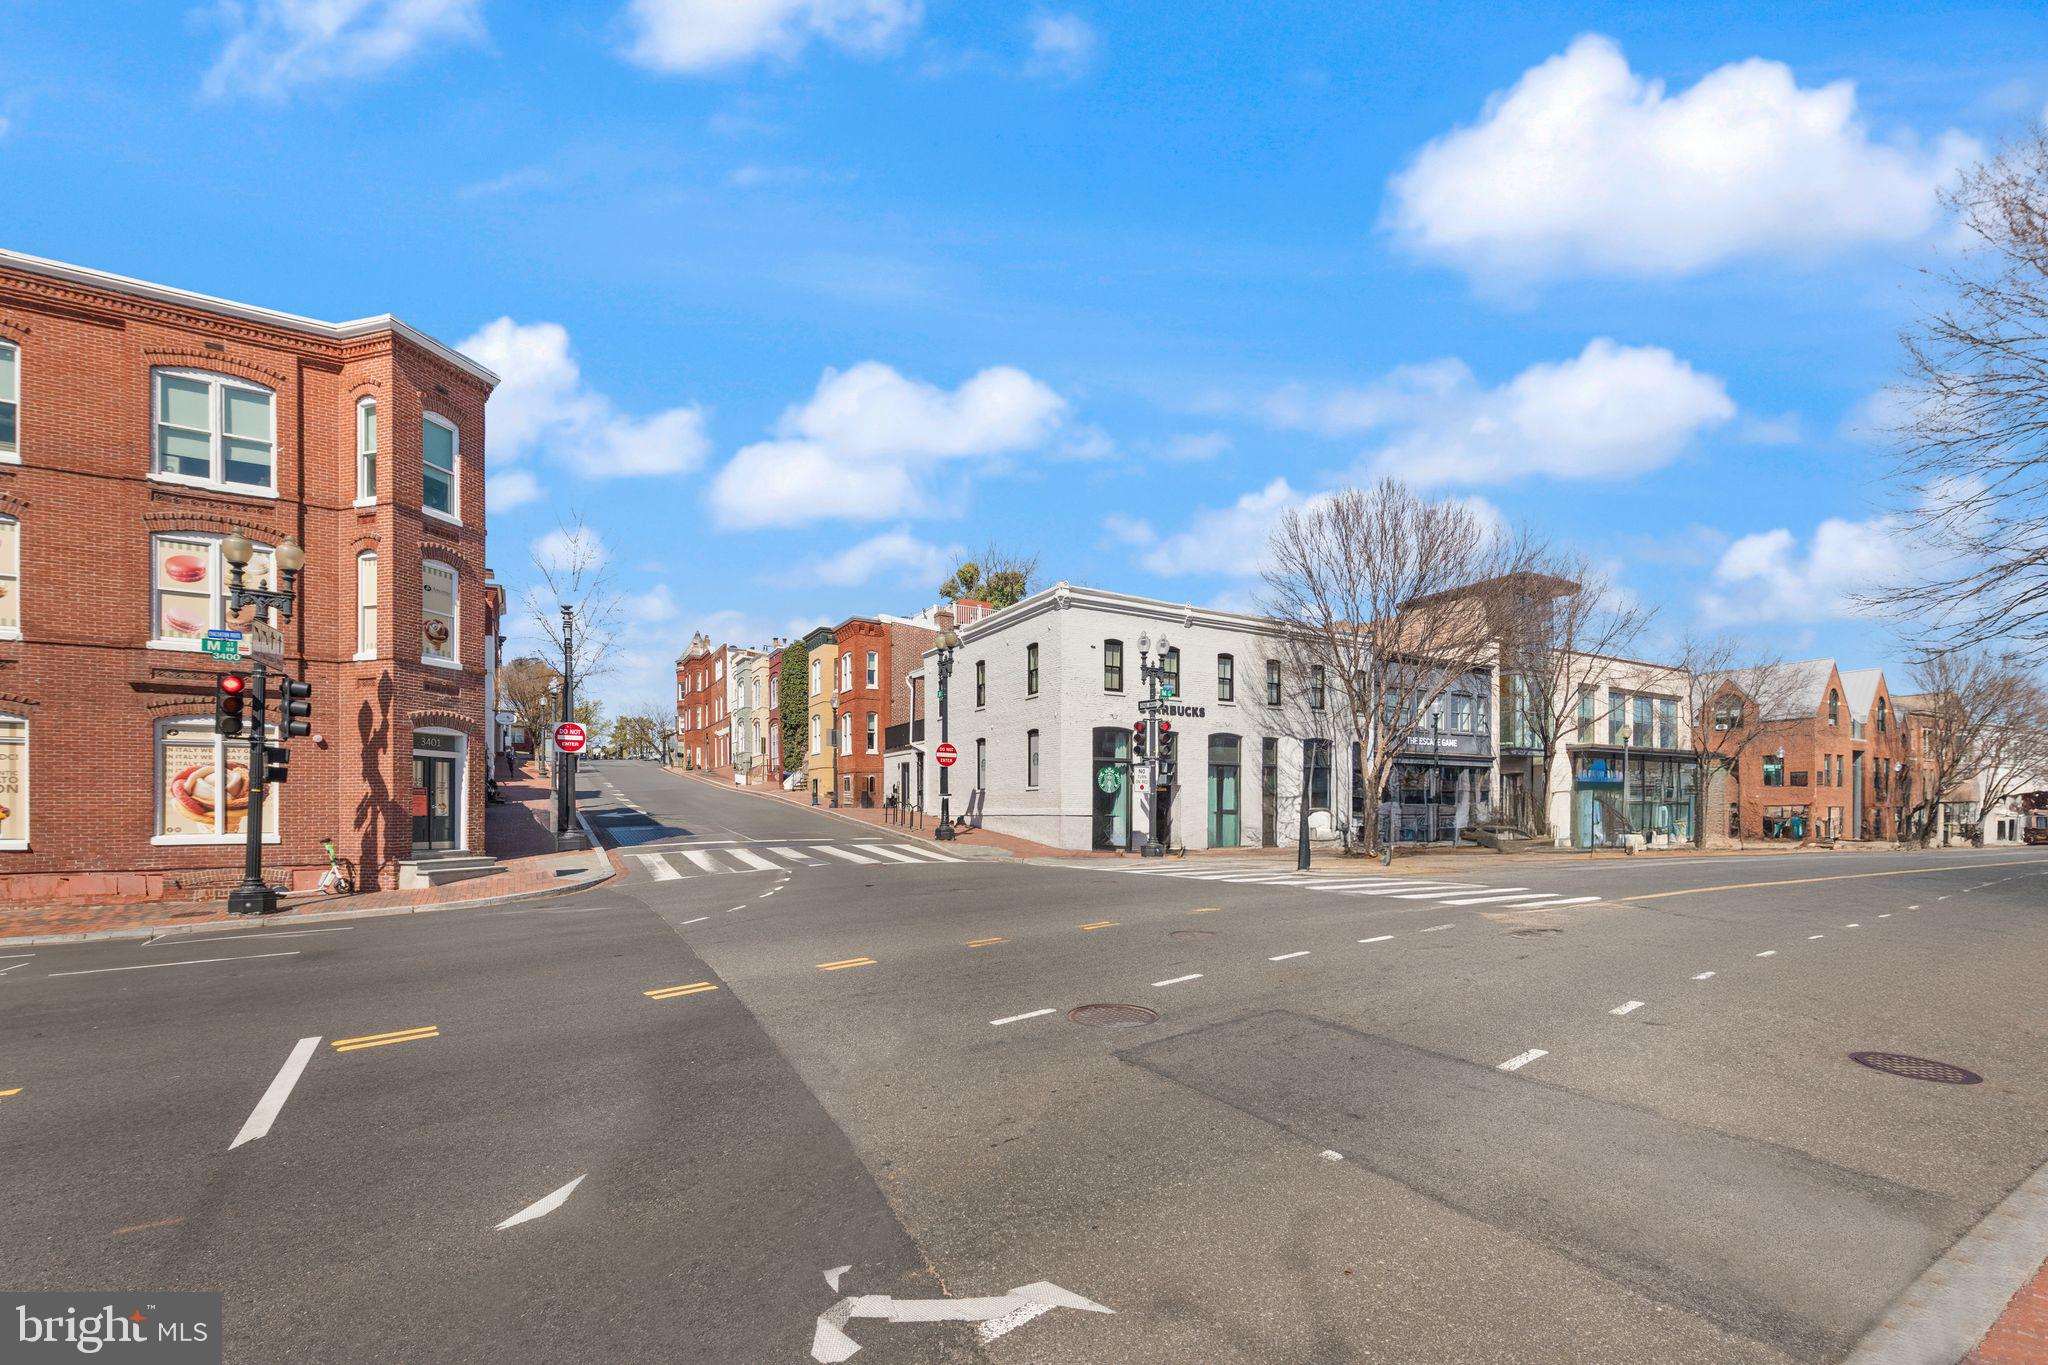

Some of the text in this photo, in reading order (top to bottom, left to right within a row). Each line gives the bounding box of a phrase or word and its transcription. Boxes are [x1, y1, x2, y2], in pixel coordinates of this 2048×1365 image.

[207, 641, 221, 651] M
[212, 652, 241, 661] 3400
[421, 738, 441, 747] 3401
[1407, 737, 1458, 747] THE ESCAE GAME
